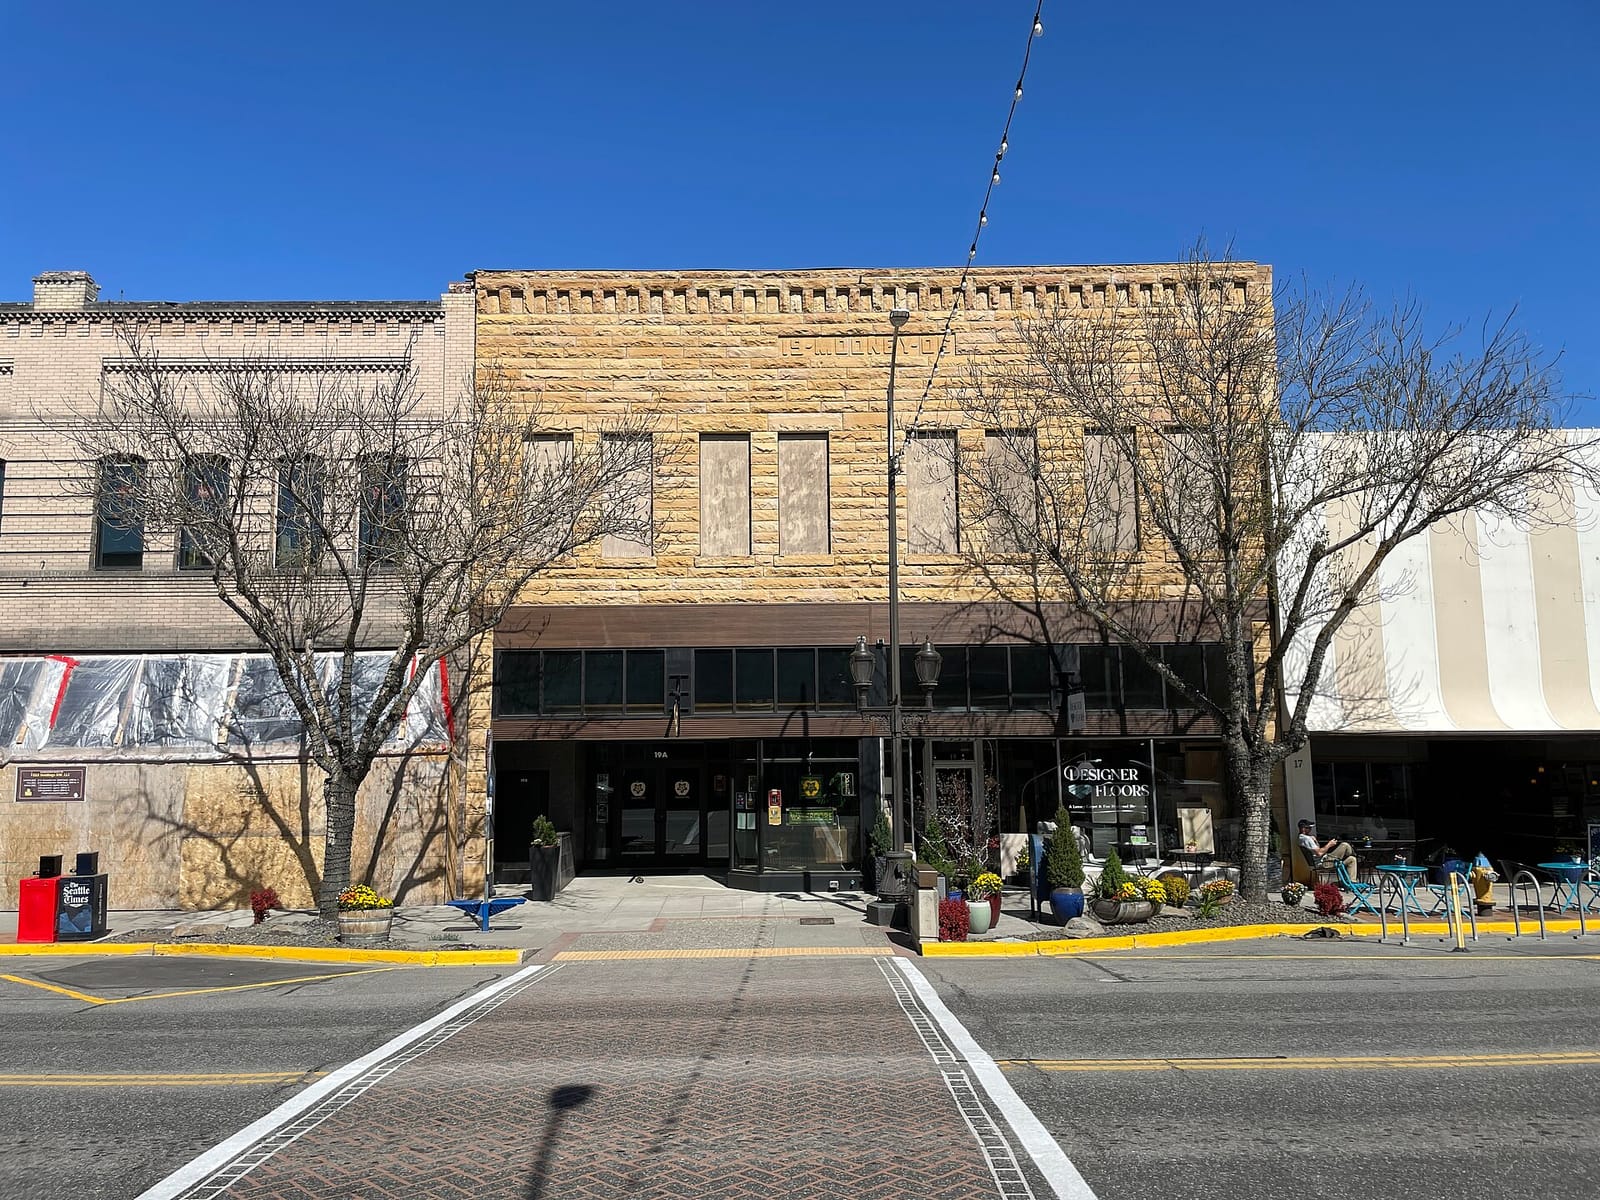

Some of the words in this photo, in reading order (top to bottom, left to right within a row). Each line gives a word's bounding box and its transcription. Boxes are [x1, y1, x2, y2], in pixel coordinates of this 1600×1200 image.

[1294, 759, 1303, 768] 17
[1063, 765, 1139, 781] DESIGNER
[1095, 784, 1150, 797] FLOORS
[63, 886, 90, 895] Seattle
[62, 893, 89, 904] Times
